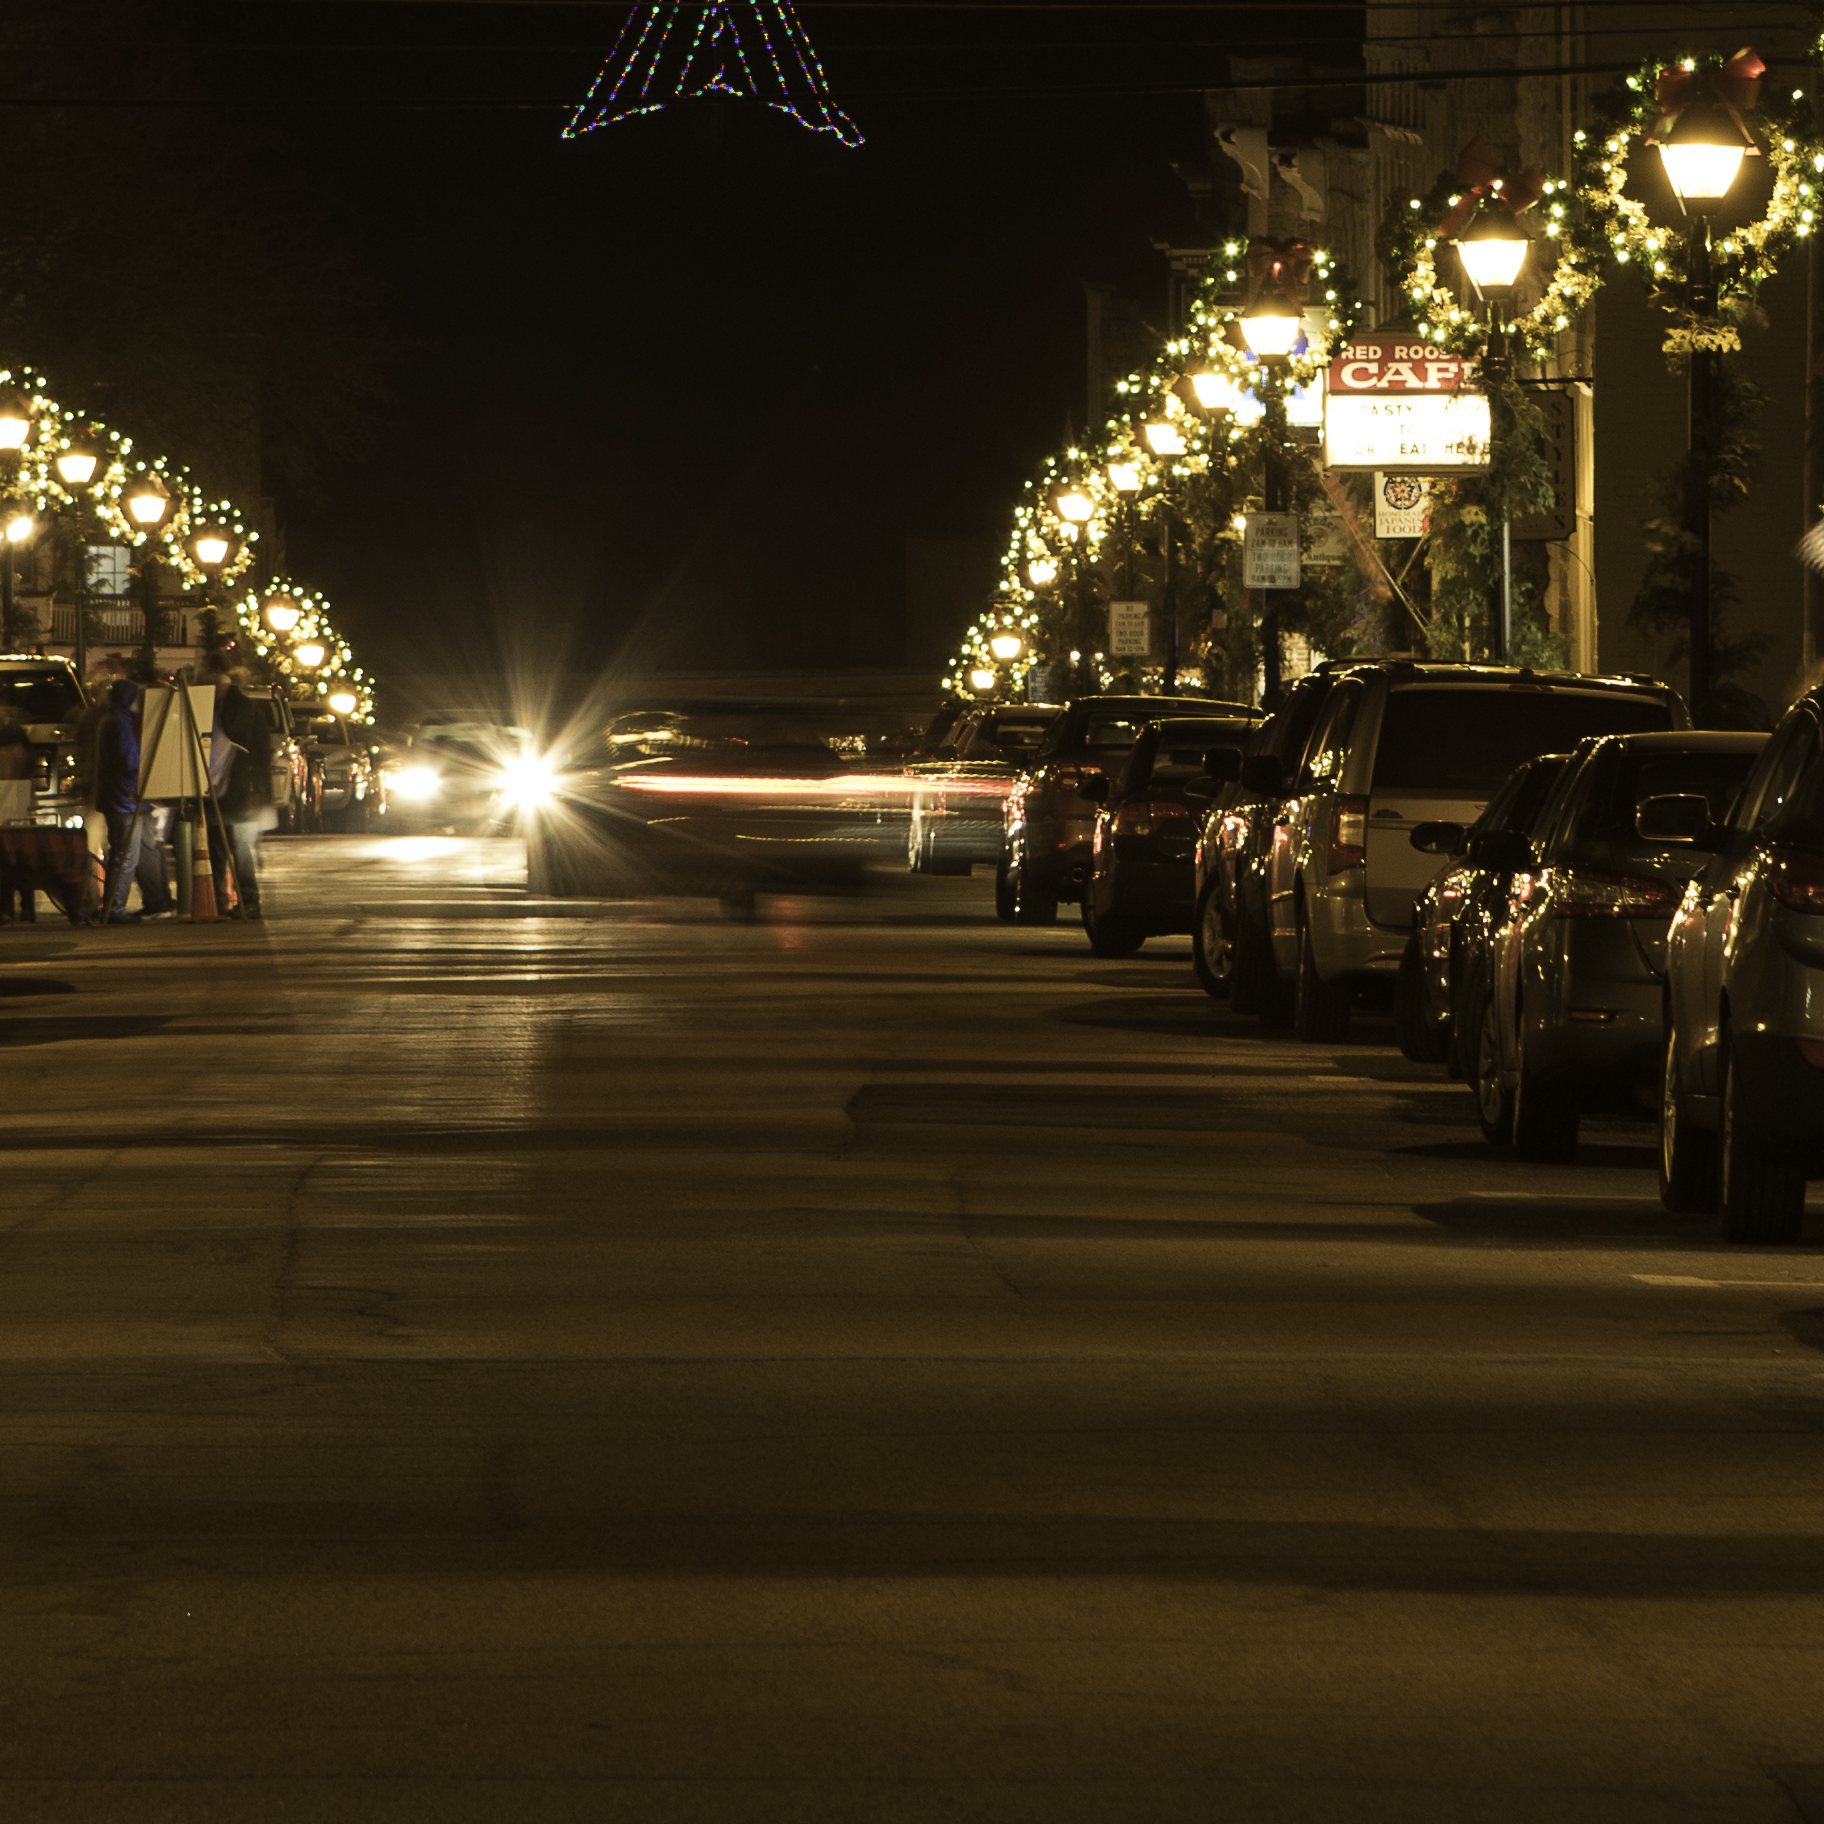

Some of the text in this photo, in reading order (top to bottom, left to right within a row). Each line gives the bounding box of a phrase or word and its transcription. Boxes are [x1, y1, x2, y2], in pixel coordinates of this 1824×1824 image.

[1340, 345, 1460, 360] RED ROOS
[1379, 518, 1423, 527] JAPANES
